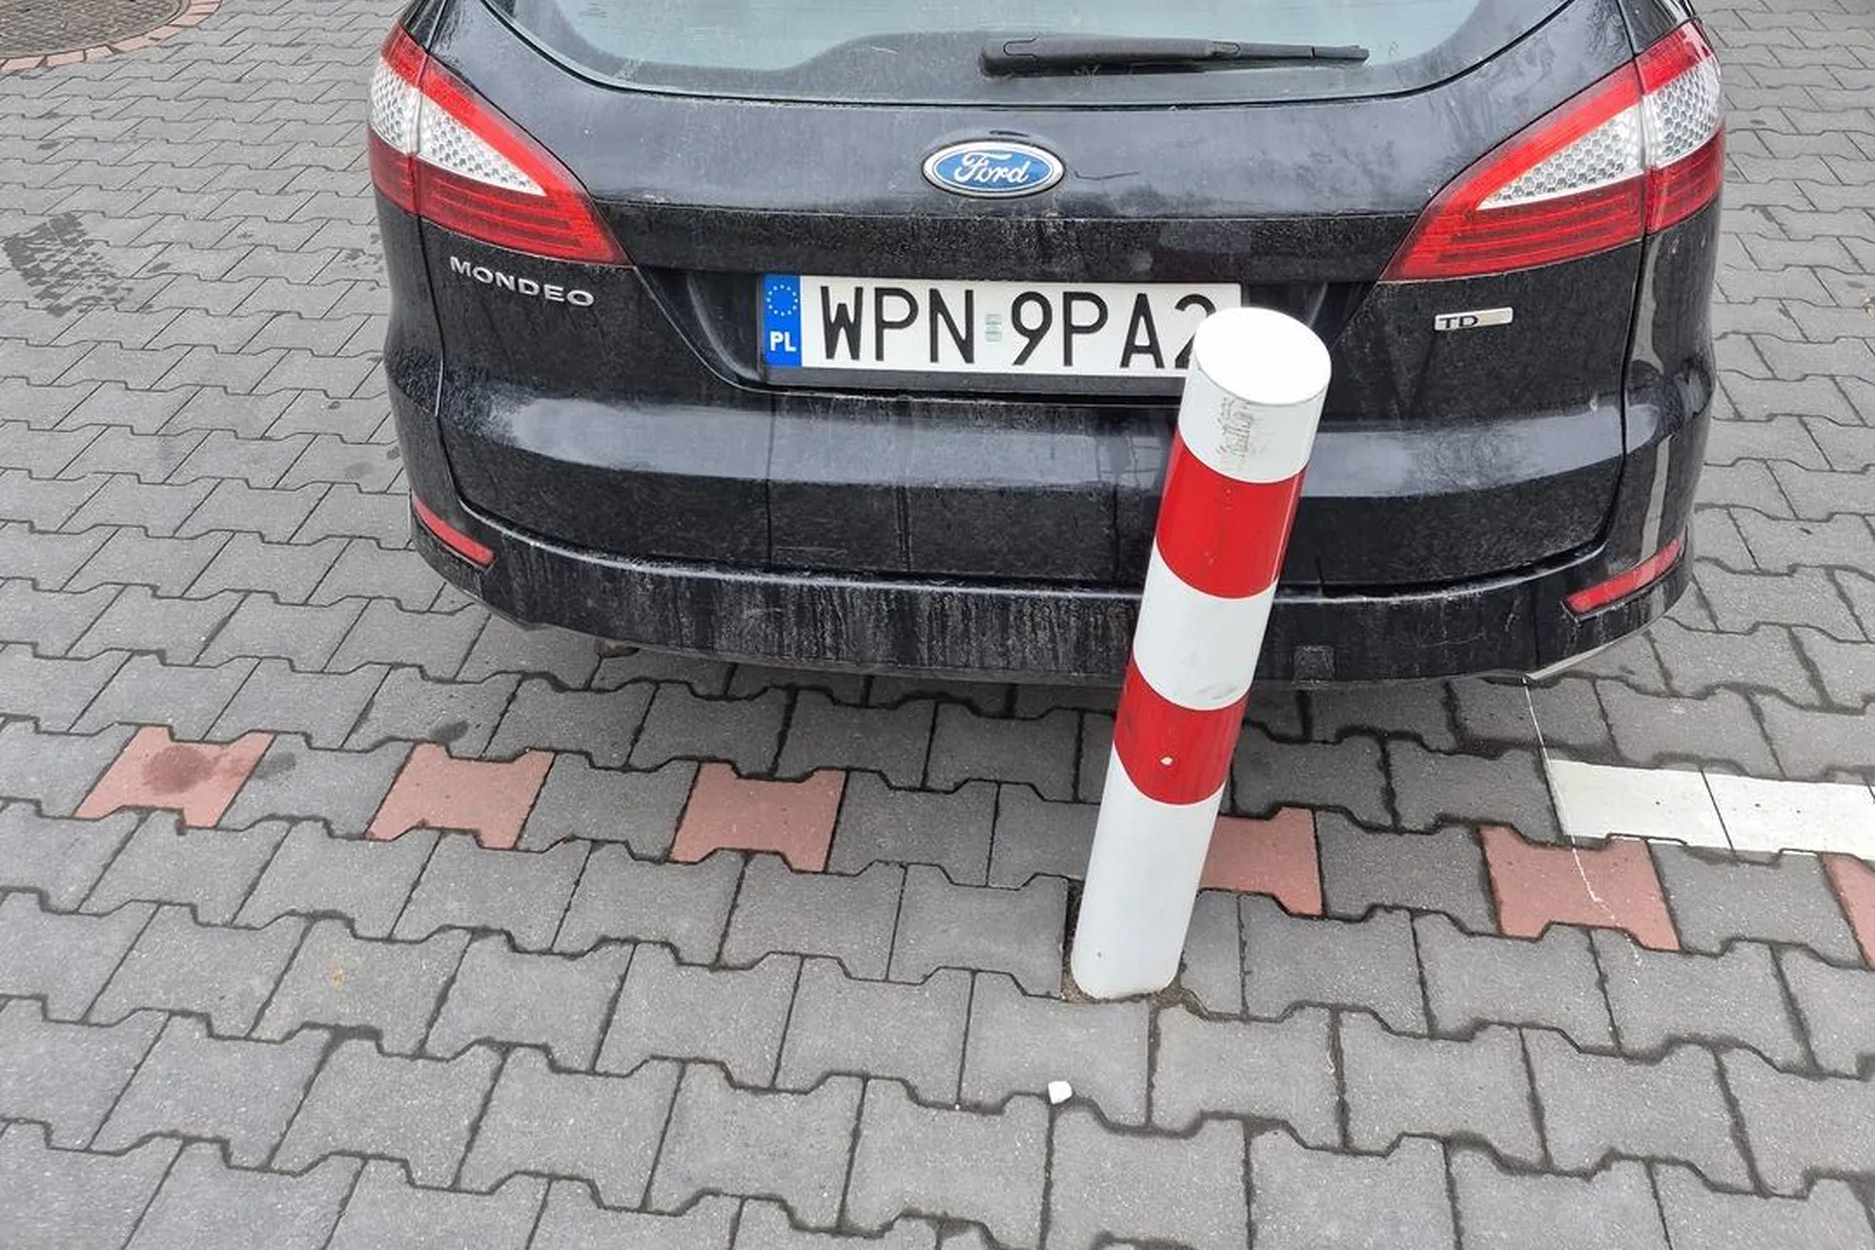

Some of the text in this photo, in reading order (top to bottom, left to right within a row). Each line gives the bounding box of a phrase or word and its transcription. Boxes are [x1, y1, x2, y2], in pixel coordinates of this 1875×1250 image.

[953, 151, 1031, 184] Ford
[450, 256, 595, 307] MONDEO
[770, 331, 797, 351] PL
[820, 286, 975, 364] WPN
